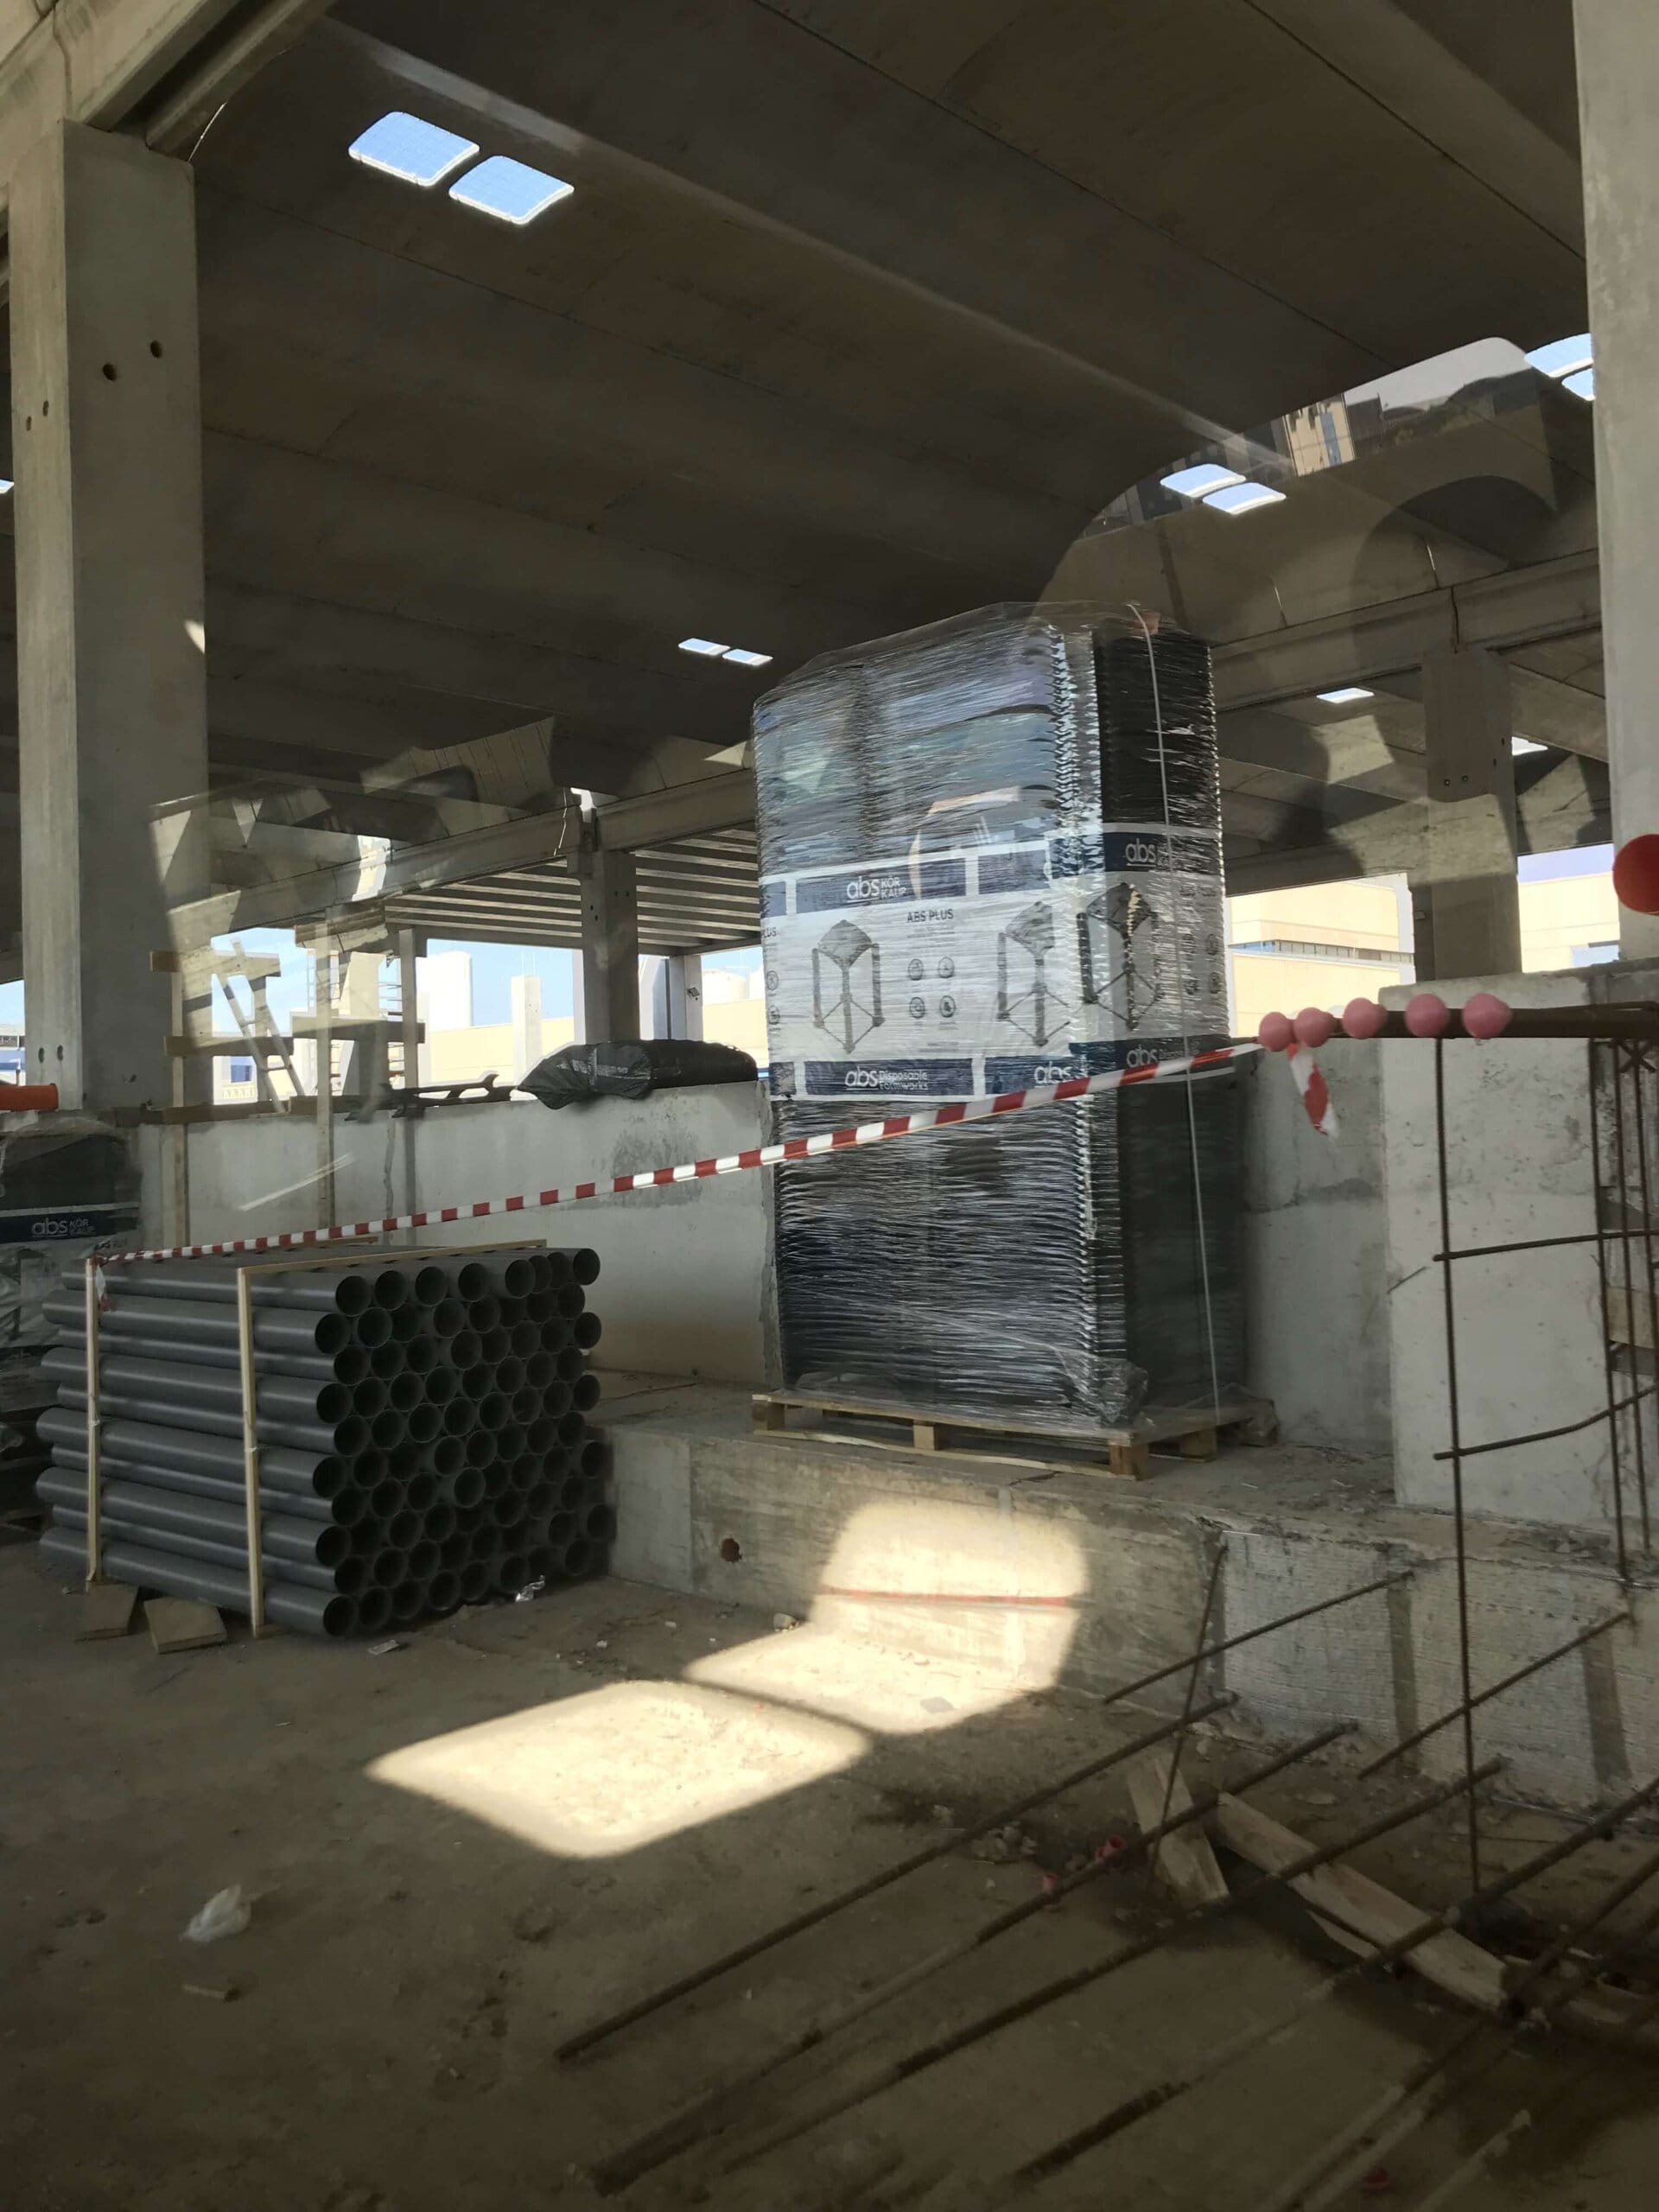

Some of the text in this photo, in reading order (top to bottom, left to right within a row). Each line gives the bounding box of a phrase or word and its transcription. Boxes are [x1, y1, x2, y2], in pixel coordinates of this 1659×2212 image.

[1125, 837, 1156, 863] abs
[846, 875, 880, 899] abs
[906, 908, 954, 923] ABS PLUS
[845, 1066, 878, 1087] abs
[32, 1217, 68, 1235] abs
